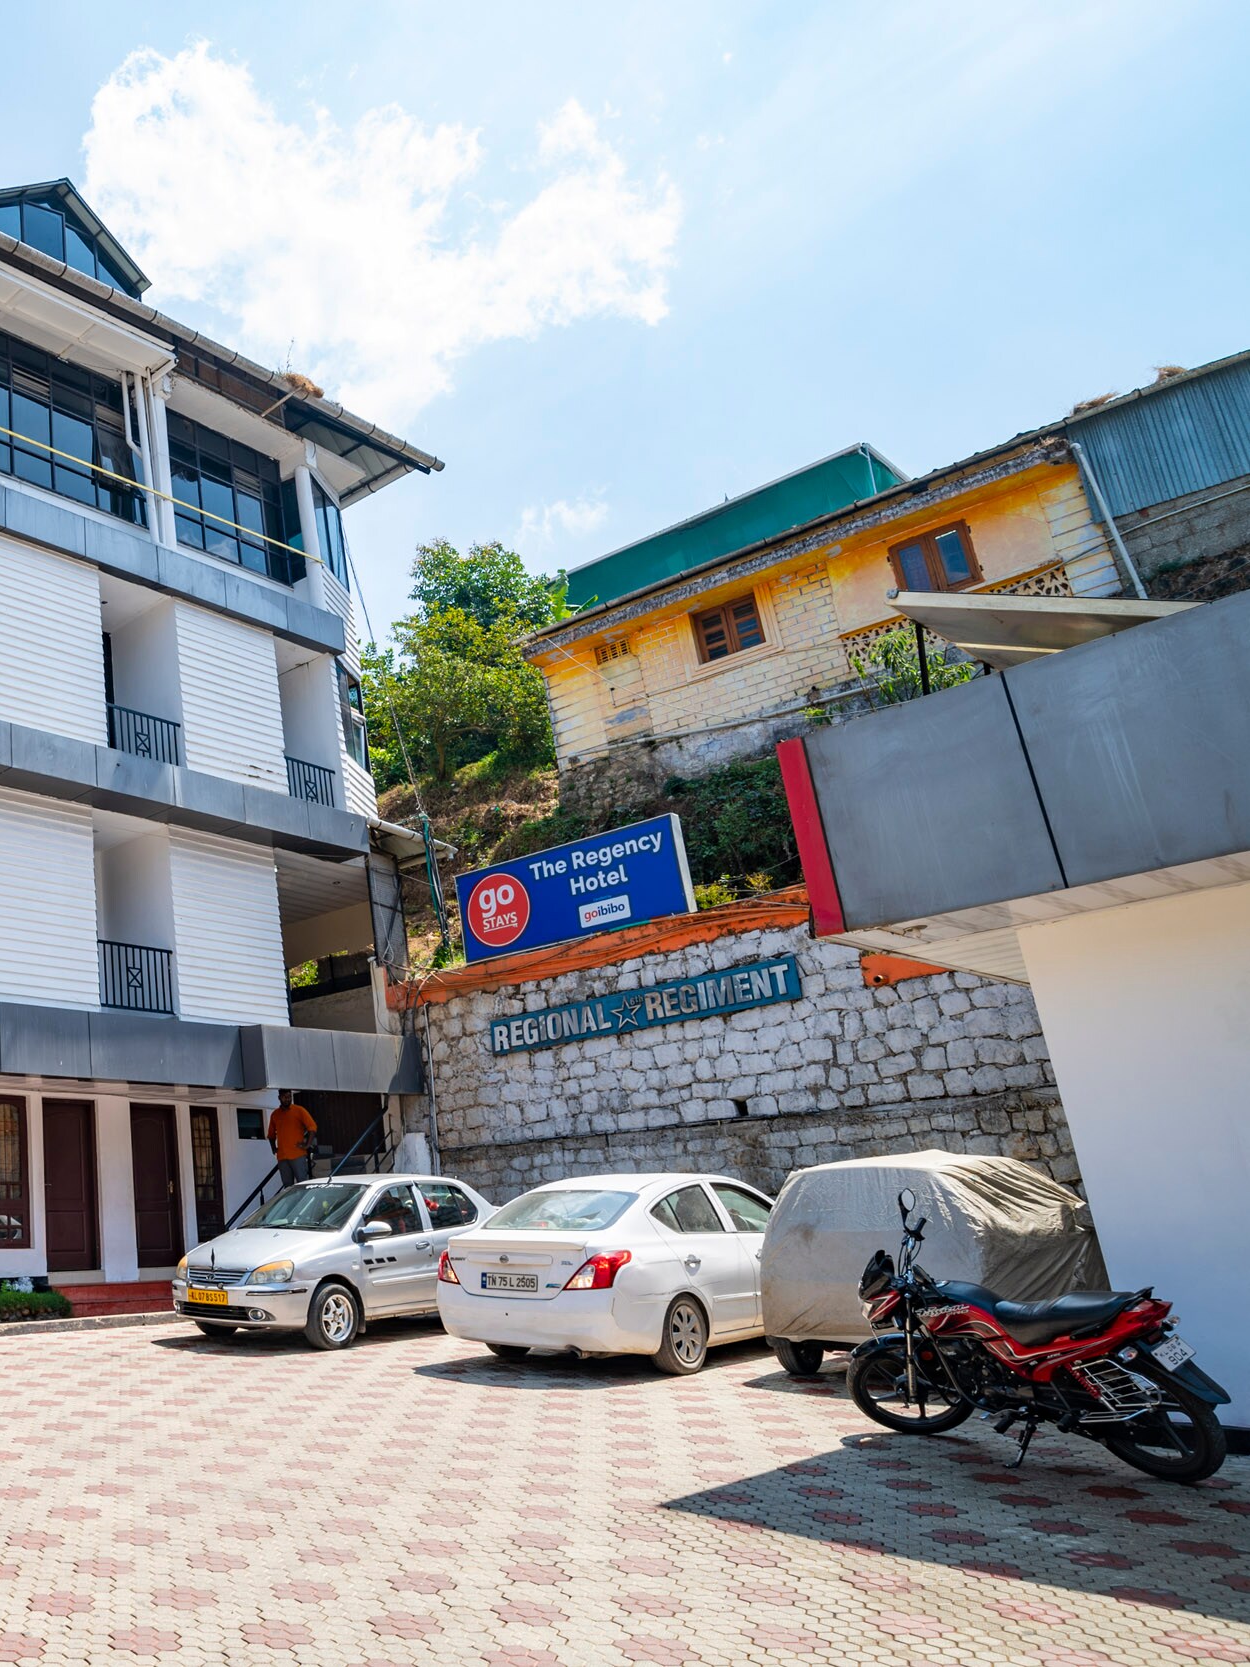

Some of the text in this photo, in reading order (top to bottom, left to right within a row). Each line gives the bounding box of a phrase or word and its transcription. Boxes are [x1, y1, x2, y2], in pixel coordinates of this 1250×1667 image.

[529, 831, 662, 881] The Regency
[569, 864, 629, 896] Hotel
[478, 884, 515, 918] go
[584, 902, 625, 922] goibibo
[483, 911, 518, 931] STAYS
[493, 1002, 612, 1052] REGIONAL
[645, 963, 789, 1021] REGIMENT
[487, 1275, 498, 1287] TN
[498, 1276, 508, 1287] 75
[509, 1277, 515, 1288] L
